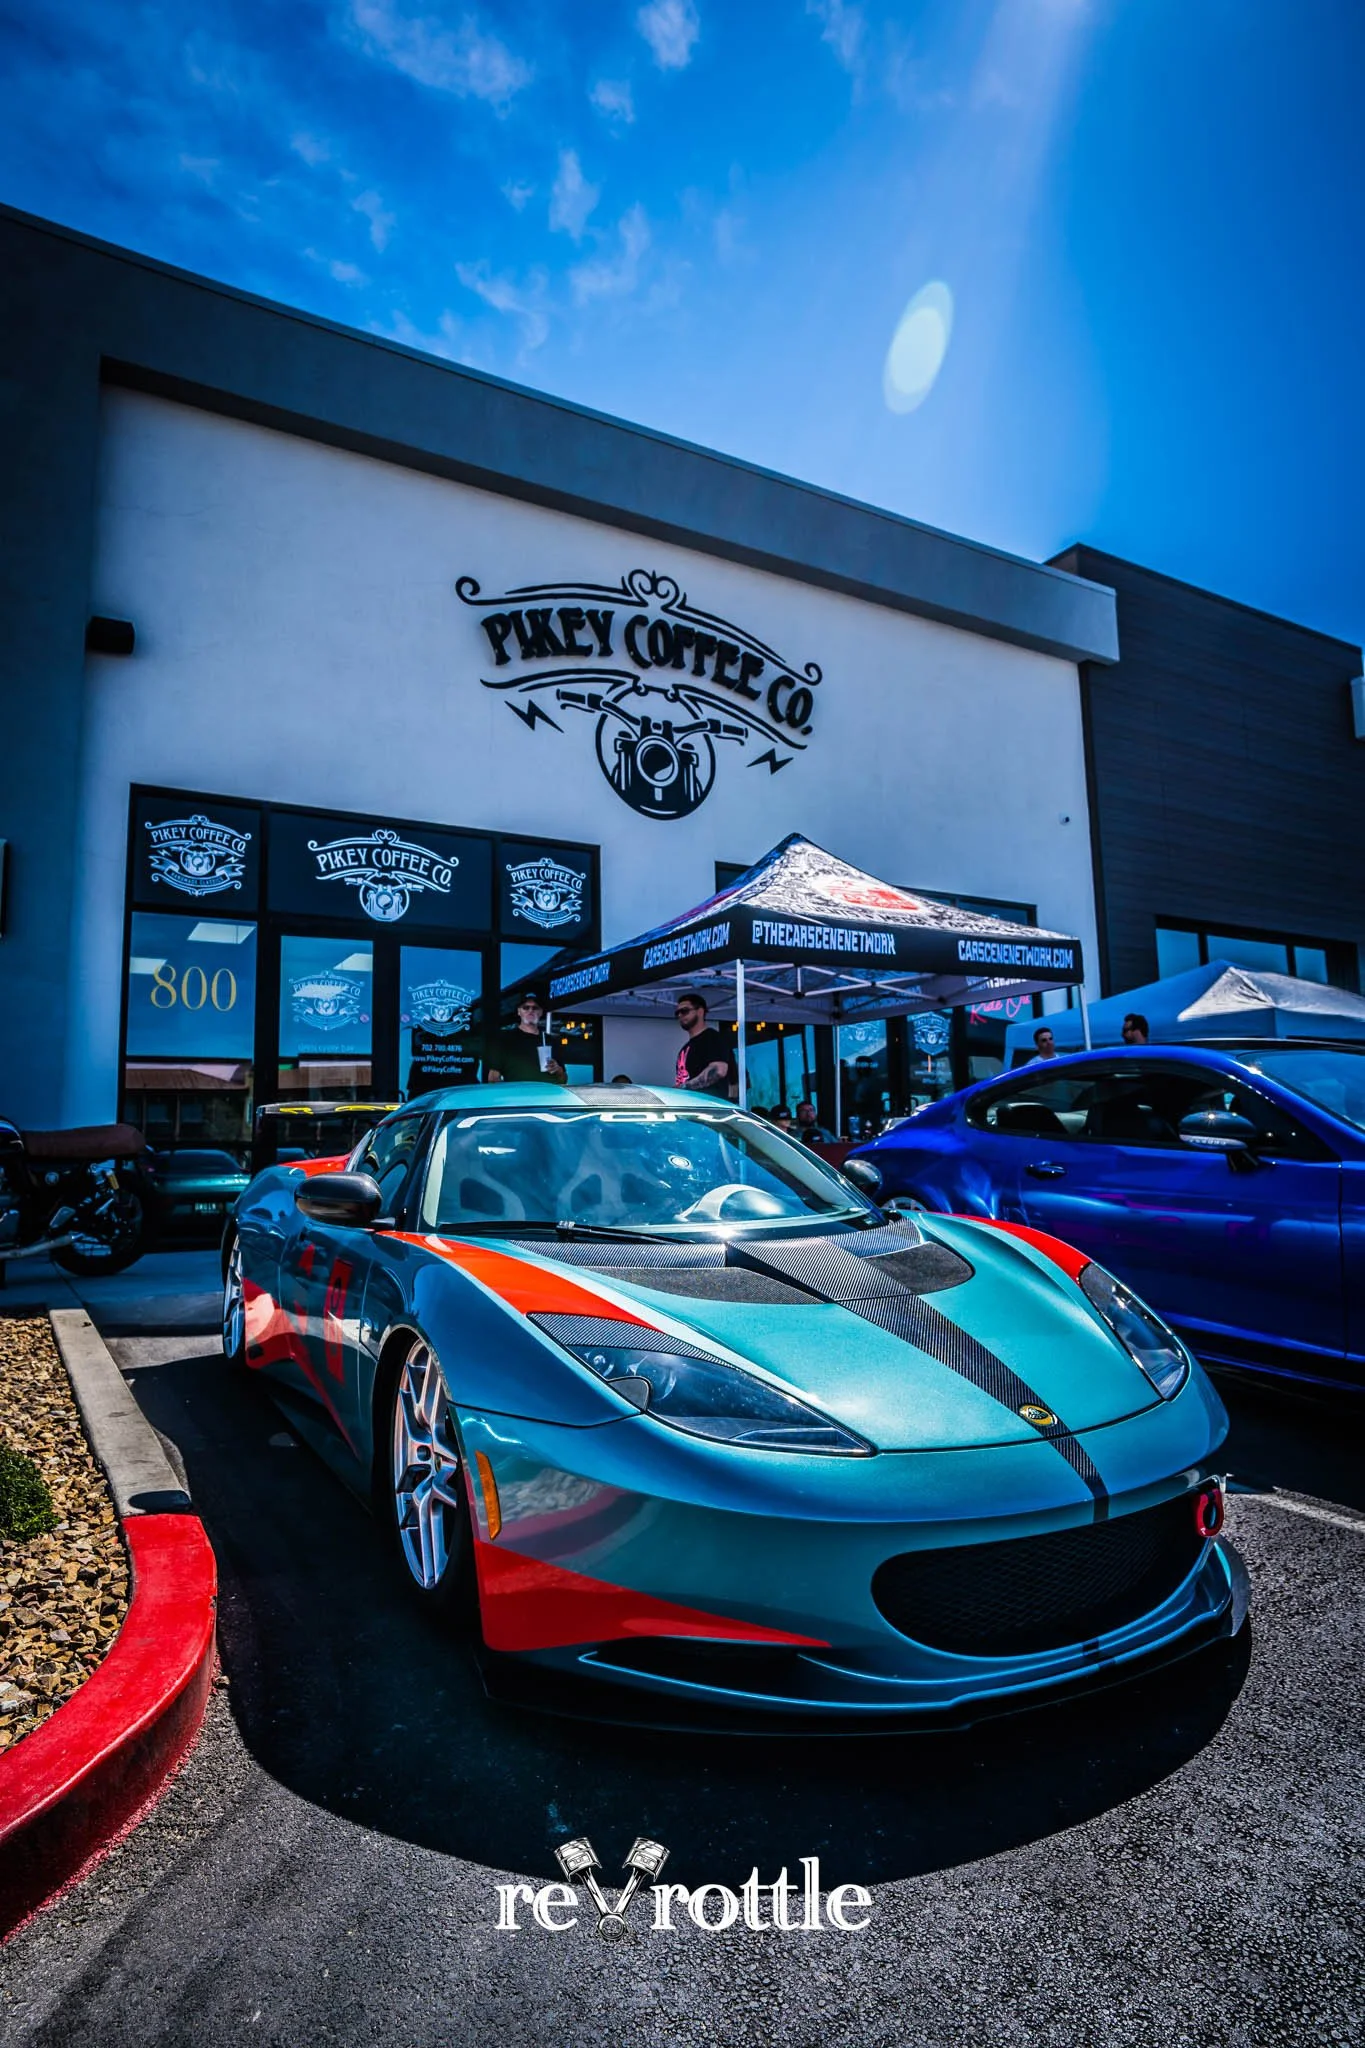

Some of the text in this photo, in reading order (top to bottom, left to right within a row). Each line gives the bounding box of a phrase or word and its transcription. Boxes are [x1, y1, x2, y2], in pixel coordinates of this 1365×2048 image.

[480, 606, 815, 736] PIKEY COFFEE CO.
[150, 827, 187, 843] PIKEY
[189, 827, 231, 846] COFFEE
[316, 848, 452, 888] PIKEY COFFEE CO.
[510, 868, 538, 882] PIKEY
[539, 868, 571, 884] COFFEE
[643, 921, 731, 969] CARSCENENETWORK.COM
[752, 920, 897, 955] @THECARSCENENETWORK
[957, 939, 1074, 969] CARSCENENETWORK.COM
[150, 963, 238, 1012] 800
[412, 988, 435, 1001] PIKEY
[436, 988, 461, 1000] COFFEE
